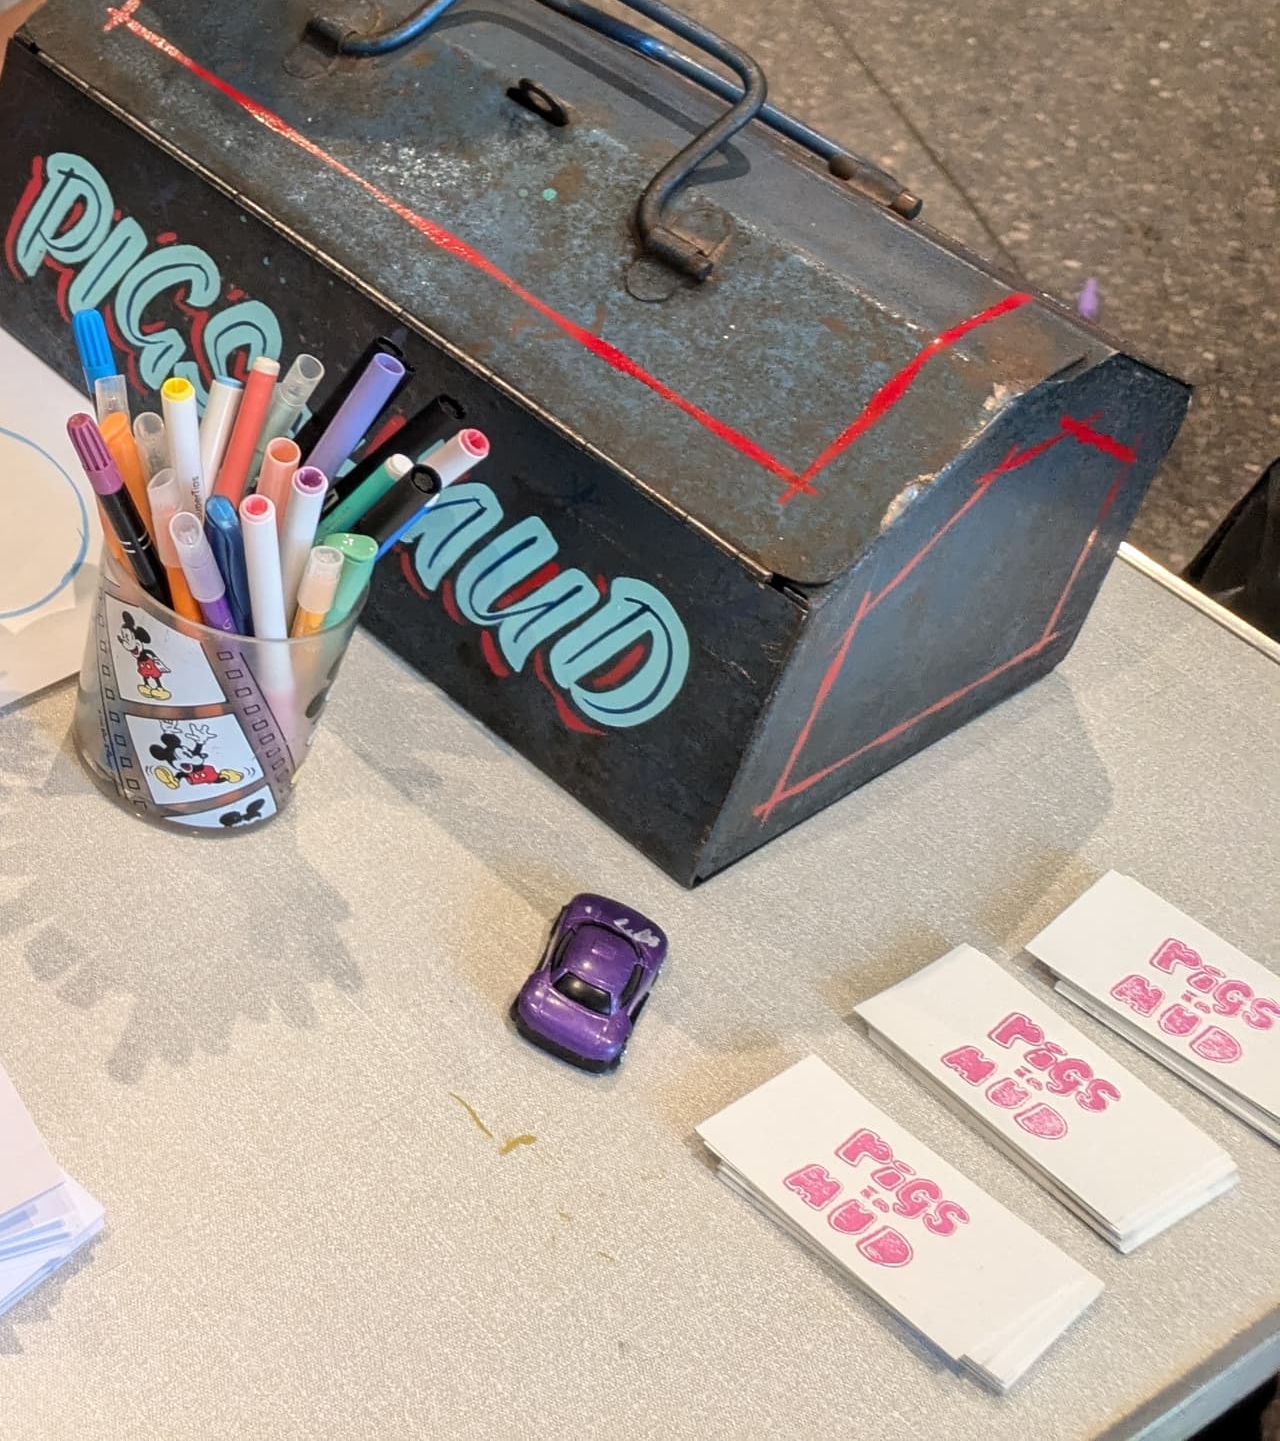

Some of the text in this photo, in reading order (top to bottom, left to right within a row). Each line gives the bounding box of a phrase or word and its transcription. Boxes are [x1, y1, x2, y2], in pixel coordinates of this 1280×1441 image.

[1110, 973, 1244, 1064] MUD
[940, 1045, 1069, 1141] MUD
[783, 1163, 915, 1269] MUD
